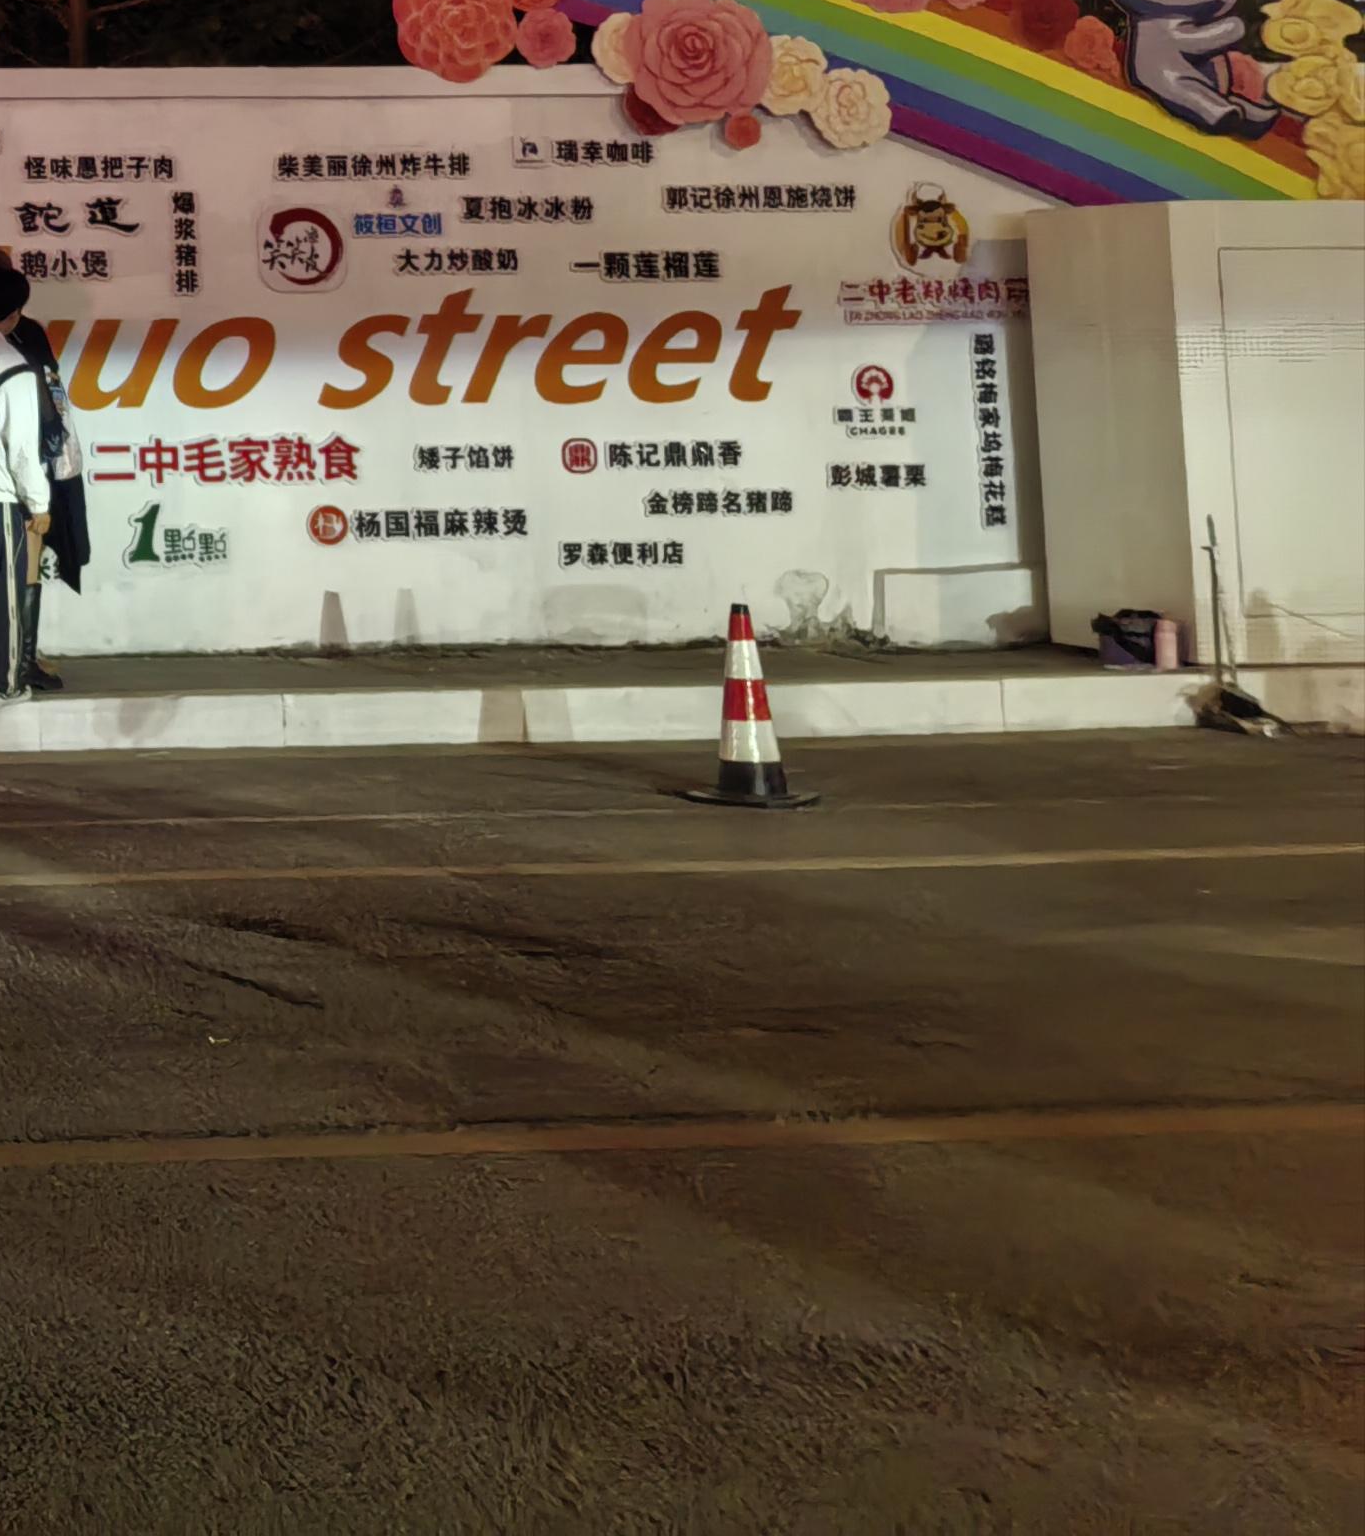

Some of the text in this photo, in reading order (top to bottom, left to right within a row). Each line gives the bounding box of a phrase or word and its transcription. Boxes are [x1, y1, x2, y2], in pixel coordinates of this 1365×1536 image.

[556, 141, 654, 163] 瑞幸咖啡
[25, 156, 172, 179] 怪味愚把子肉
[278, 155, 470, 176] 柴美丽徐州炸牛排
[666, 186, 855, 208] 郭记徐州恩施烧饼
[173, 192, 198, 292] 爆浆猪排
[398, 249, 517, 271] 大力炒酸奶
[574, 252, 719, 278] 一颗莲榴莲
[317, 287, 800, 409] street
[93, 436, 360, 483] 二中毛家熟食
[608, 441, 742, 468] 陈记鼎鼎香
[647, 490, 792, 514] 金榜蹄名猪蹄
[356, 510, 527, 537] 杨国福麻辣烫
[563, 542, 684, 565] 罗森便利店
